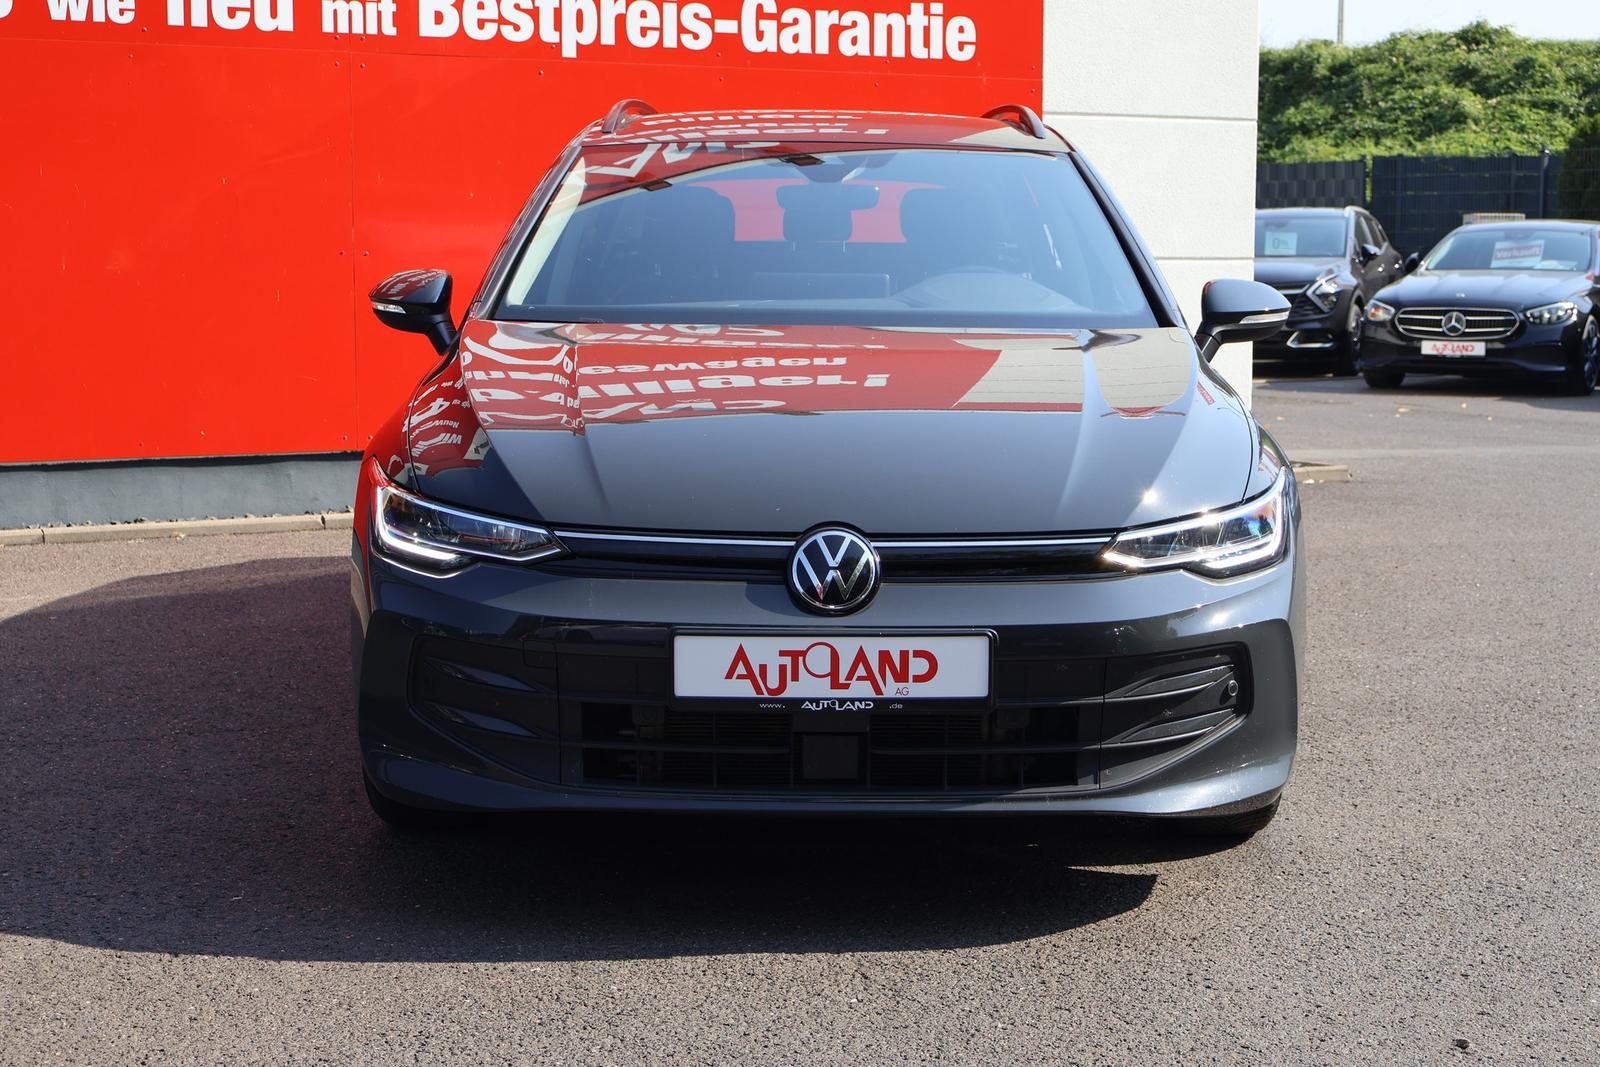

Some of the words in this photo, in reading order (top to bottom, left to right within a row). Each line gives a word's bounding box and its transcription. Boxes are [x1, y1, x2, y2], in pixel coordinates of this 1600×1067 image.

[46, 0, 136, 25] wie
[166, 0, 295, 32] neu
[321, 0, 398, 37] mit
[418, 0, 977, 62] Bestpreis-Garantie
[724, 641, 939, 697] AUTOLAND
[758, 702, 786, 710] www.
[800, 698, 875, 711] AUTOLAND
[888, 701, 904, 710] .de
[894, 686, 910, 697] AG
